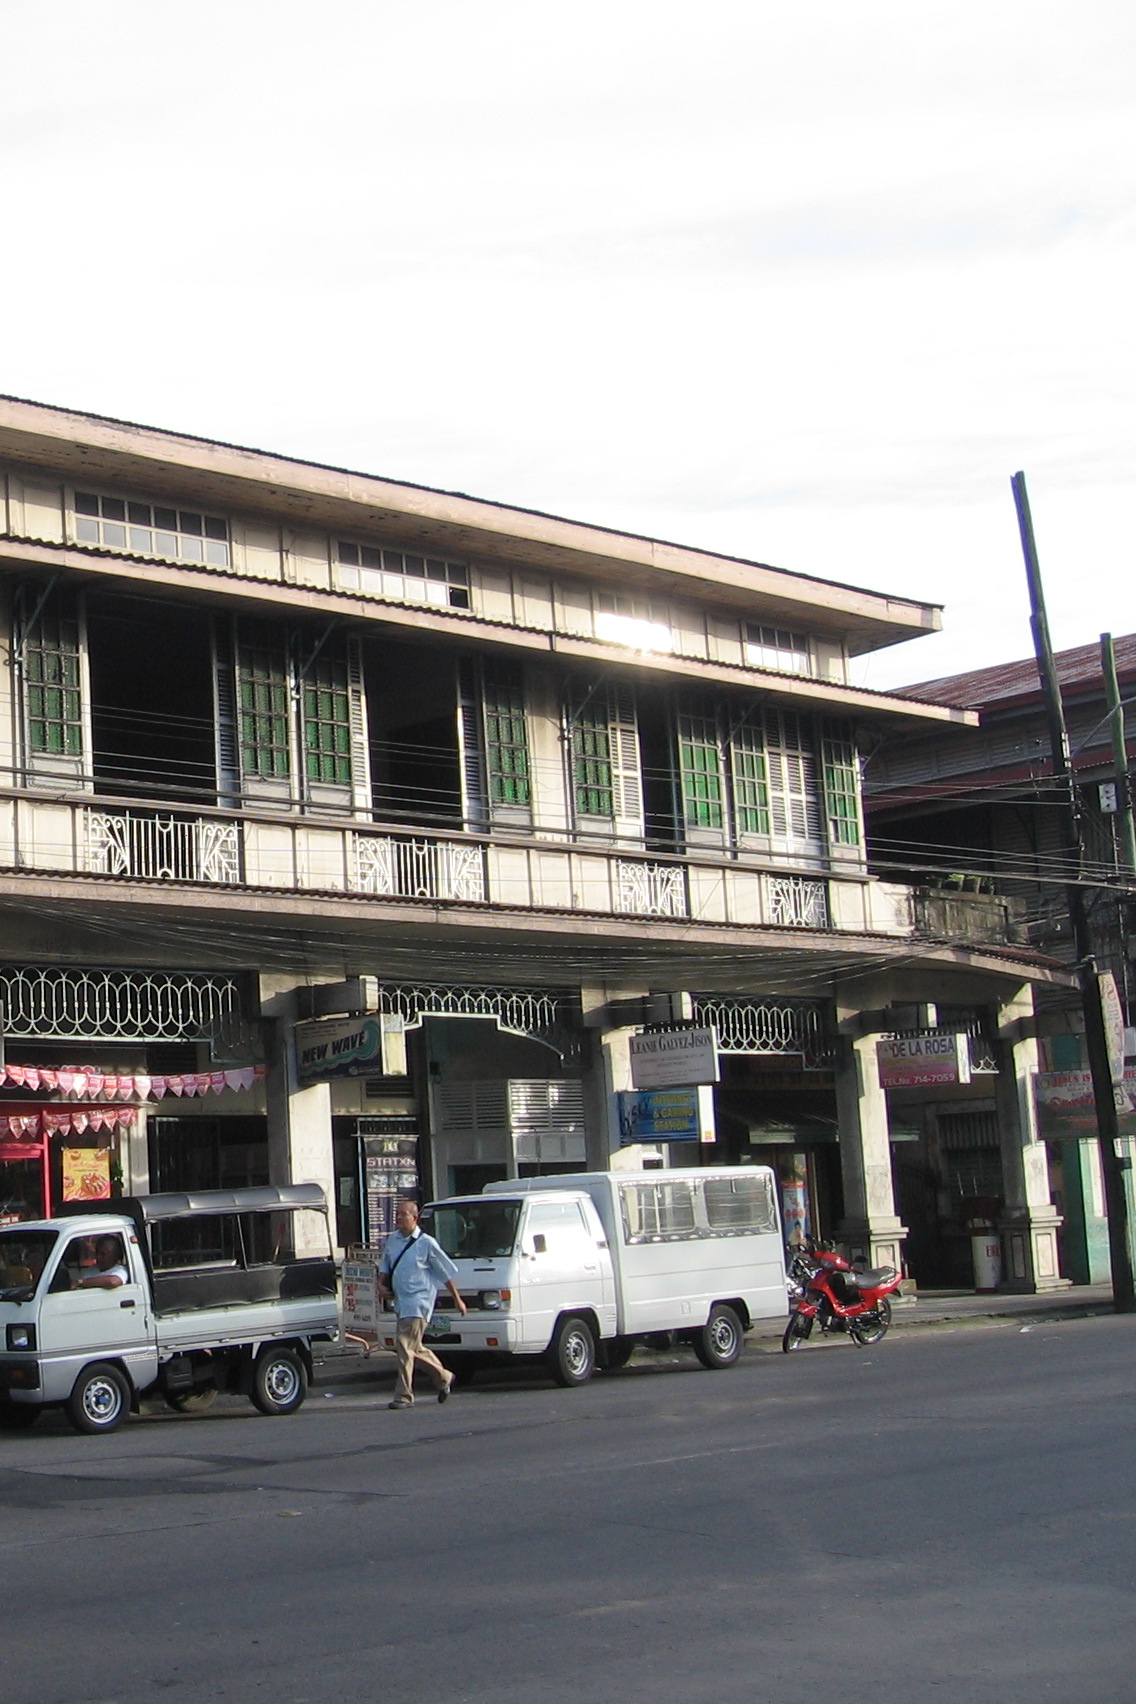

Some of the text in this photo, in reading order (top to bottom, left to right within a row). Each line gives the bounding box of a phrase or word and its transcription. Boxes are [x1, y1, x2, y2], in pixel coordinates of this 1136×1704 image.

[302, 1031, 367, 1066] NEW WAVE
[924, 1038, 955, 1055] ROSA
